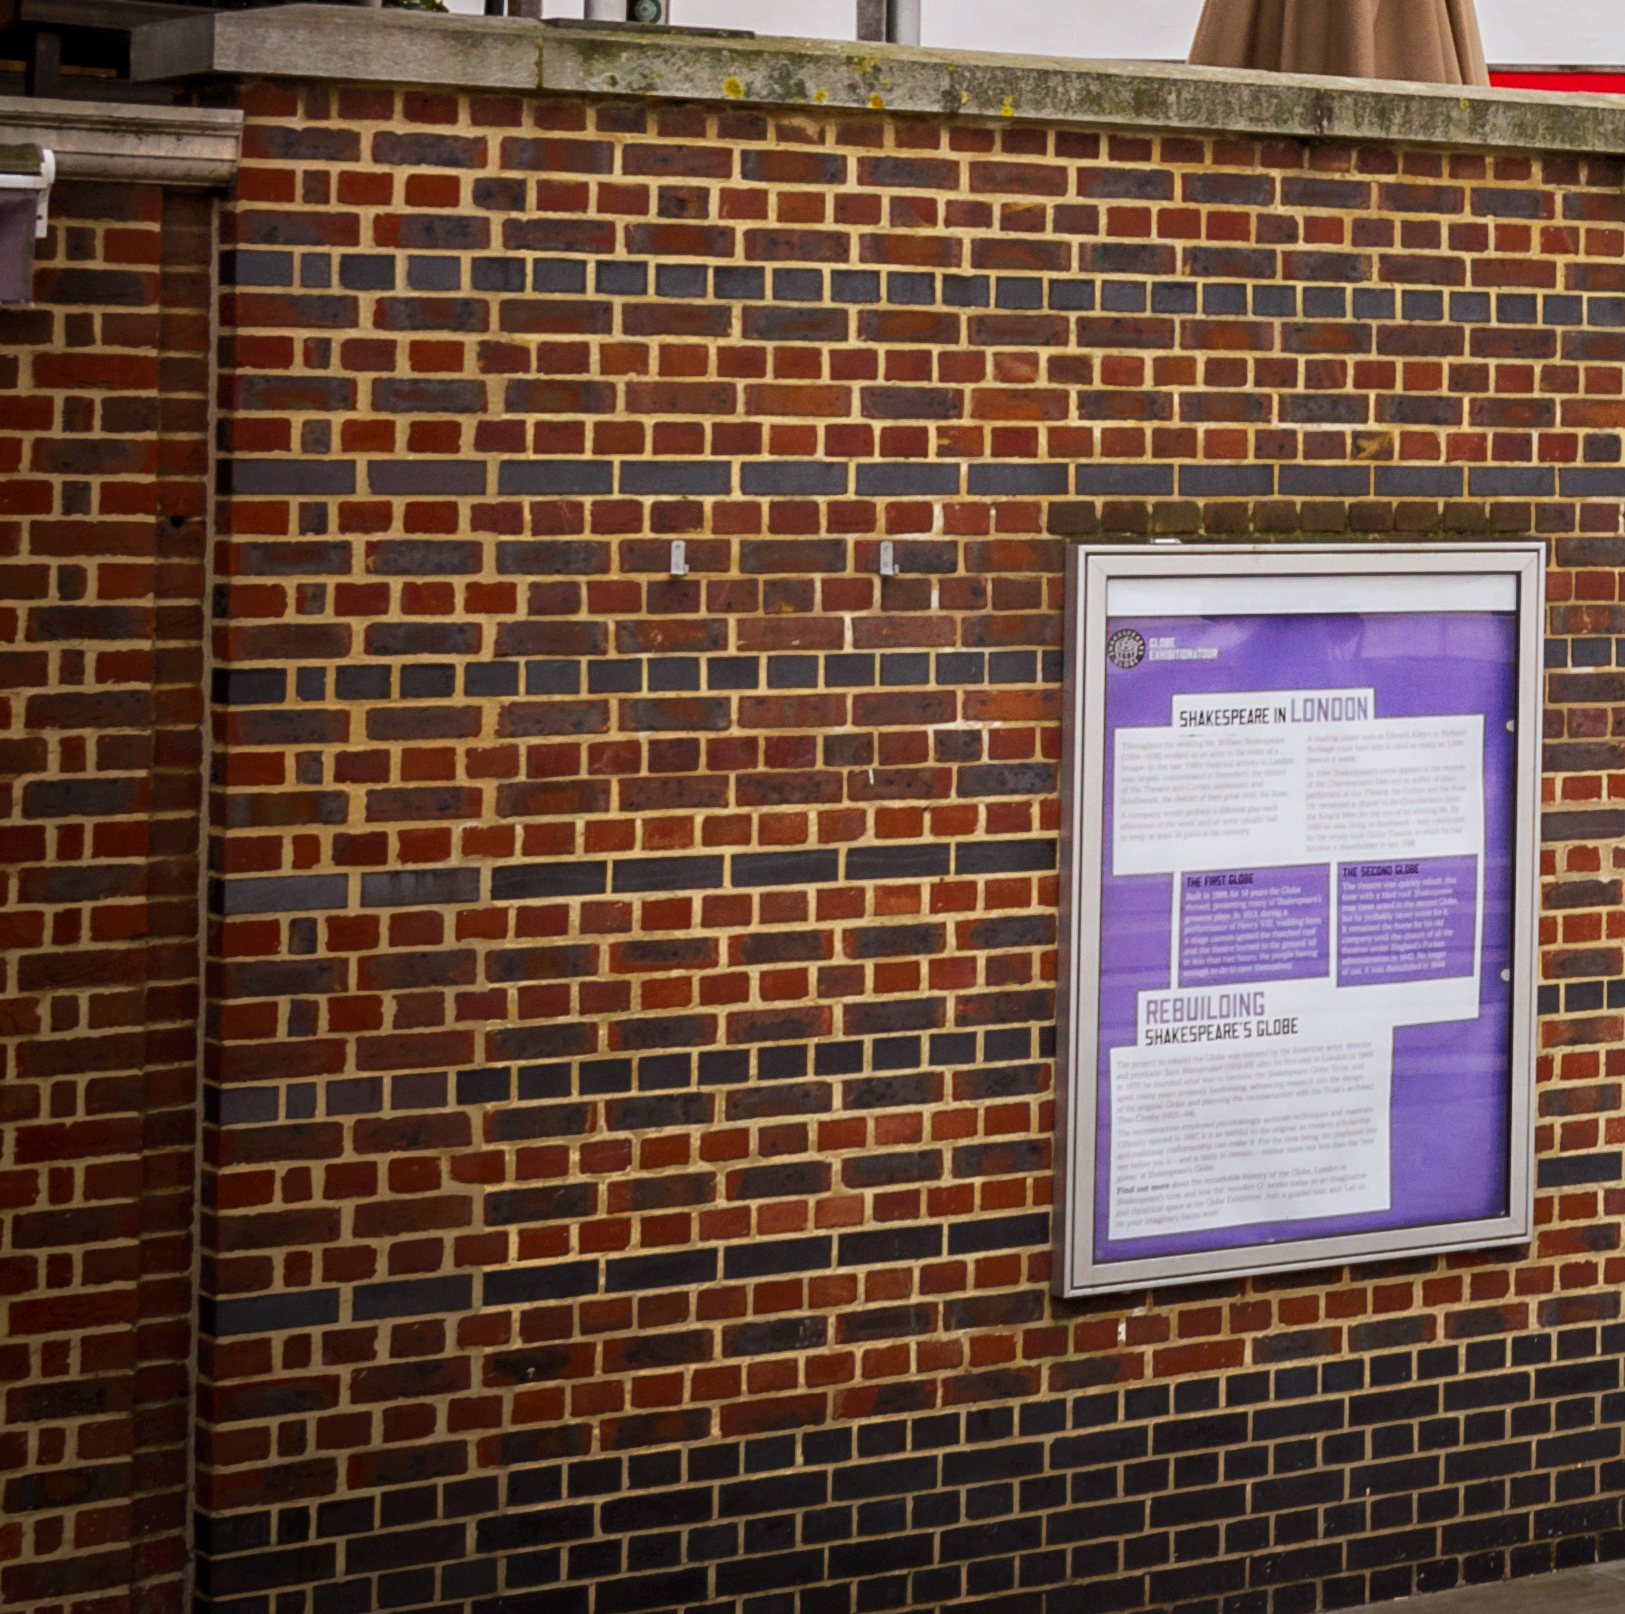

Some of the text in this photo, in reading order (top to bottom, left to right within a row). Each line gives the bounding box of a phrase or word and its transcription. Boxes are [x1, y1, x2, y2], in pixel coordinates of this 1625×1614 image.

[1179, 695, 1369, 728] SHAKESPEARE IN LONDON
[1145, 990, 1266, 1026] REBUILDING
[1144, 1016, 1299, 1047] SHAKESPEARE'S GLOBE
